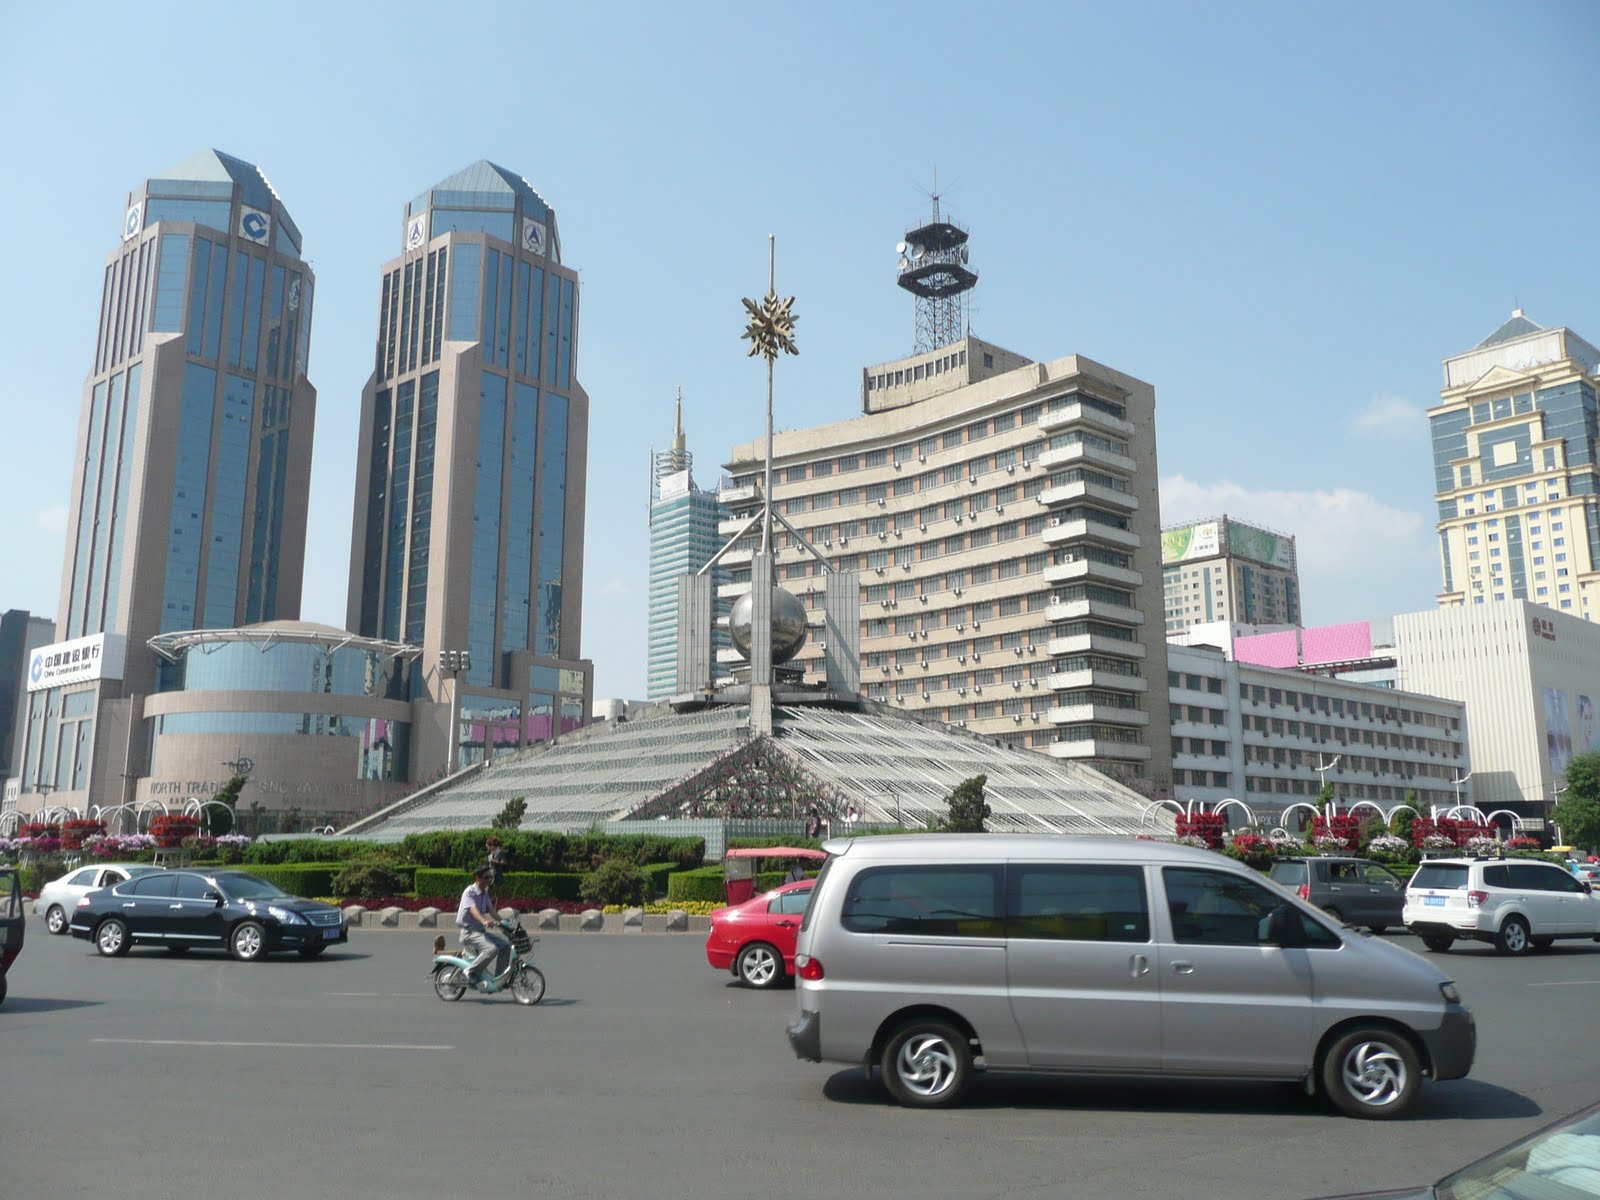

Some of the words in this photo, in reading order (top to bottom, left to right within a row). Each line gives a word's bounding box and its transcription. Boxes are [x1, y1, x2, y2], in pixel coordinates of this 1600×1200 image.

[45, 643, 101, 668] 中国建设银行
[150, 781, 180, 794] NORTH
